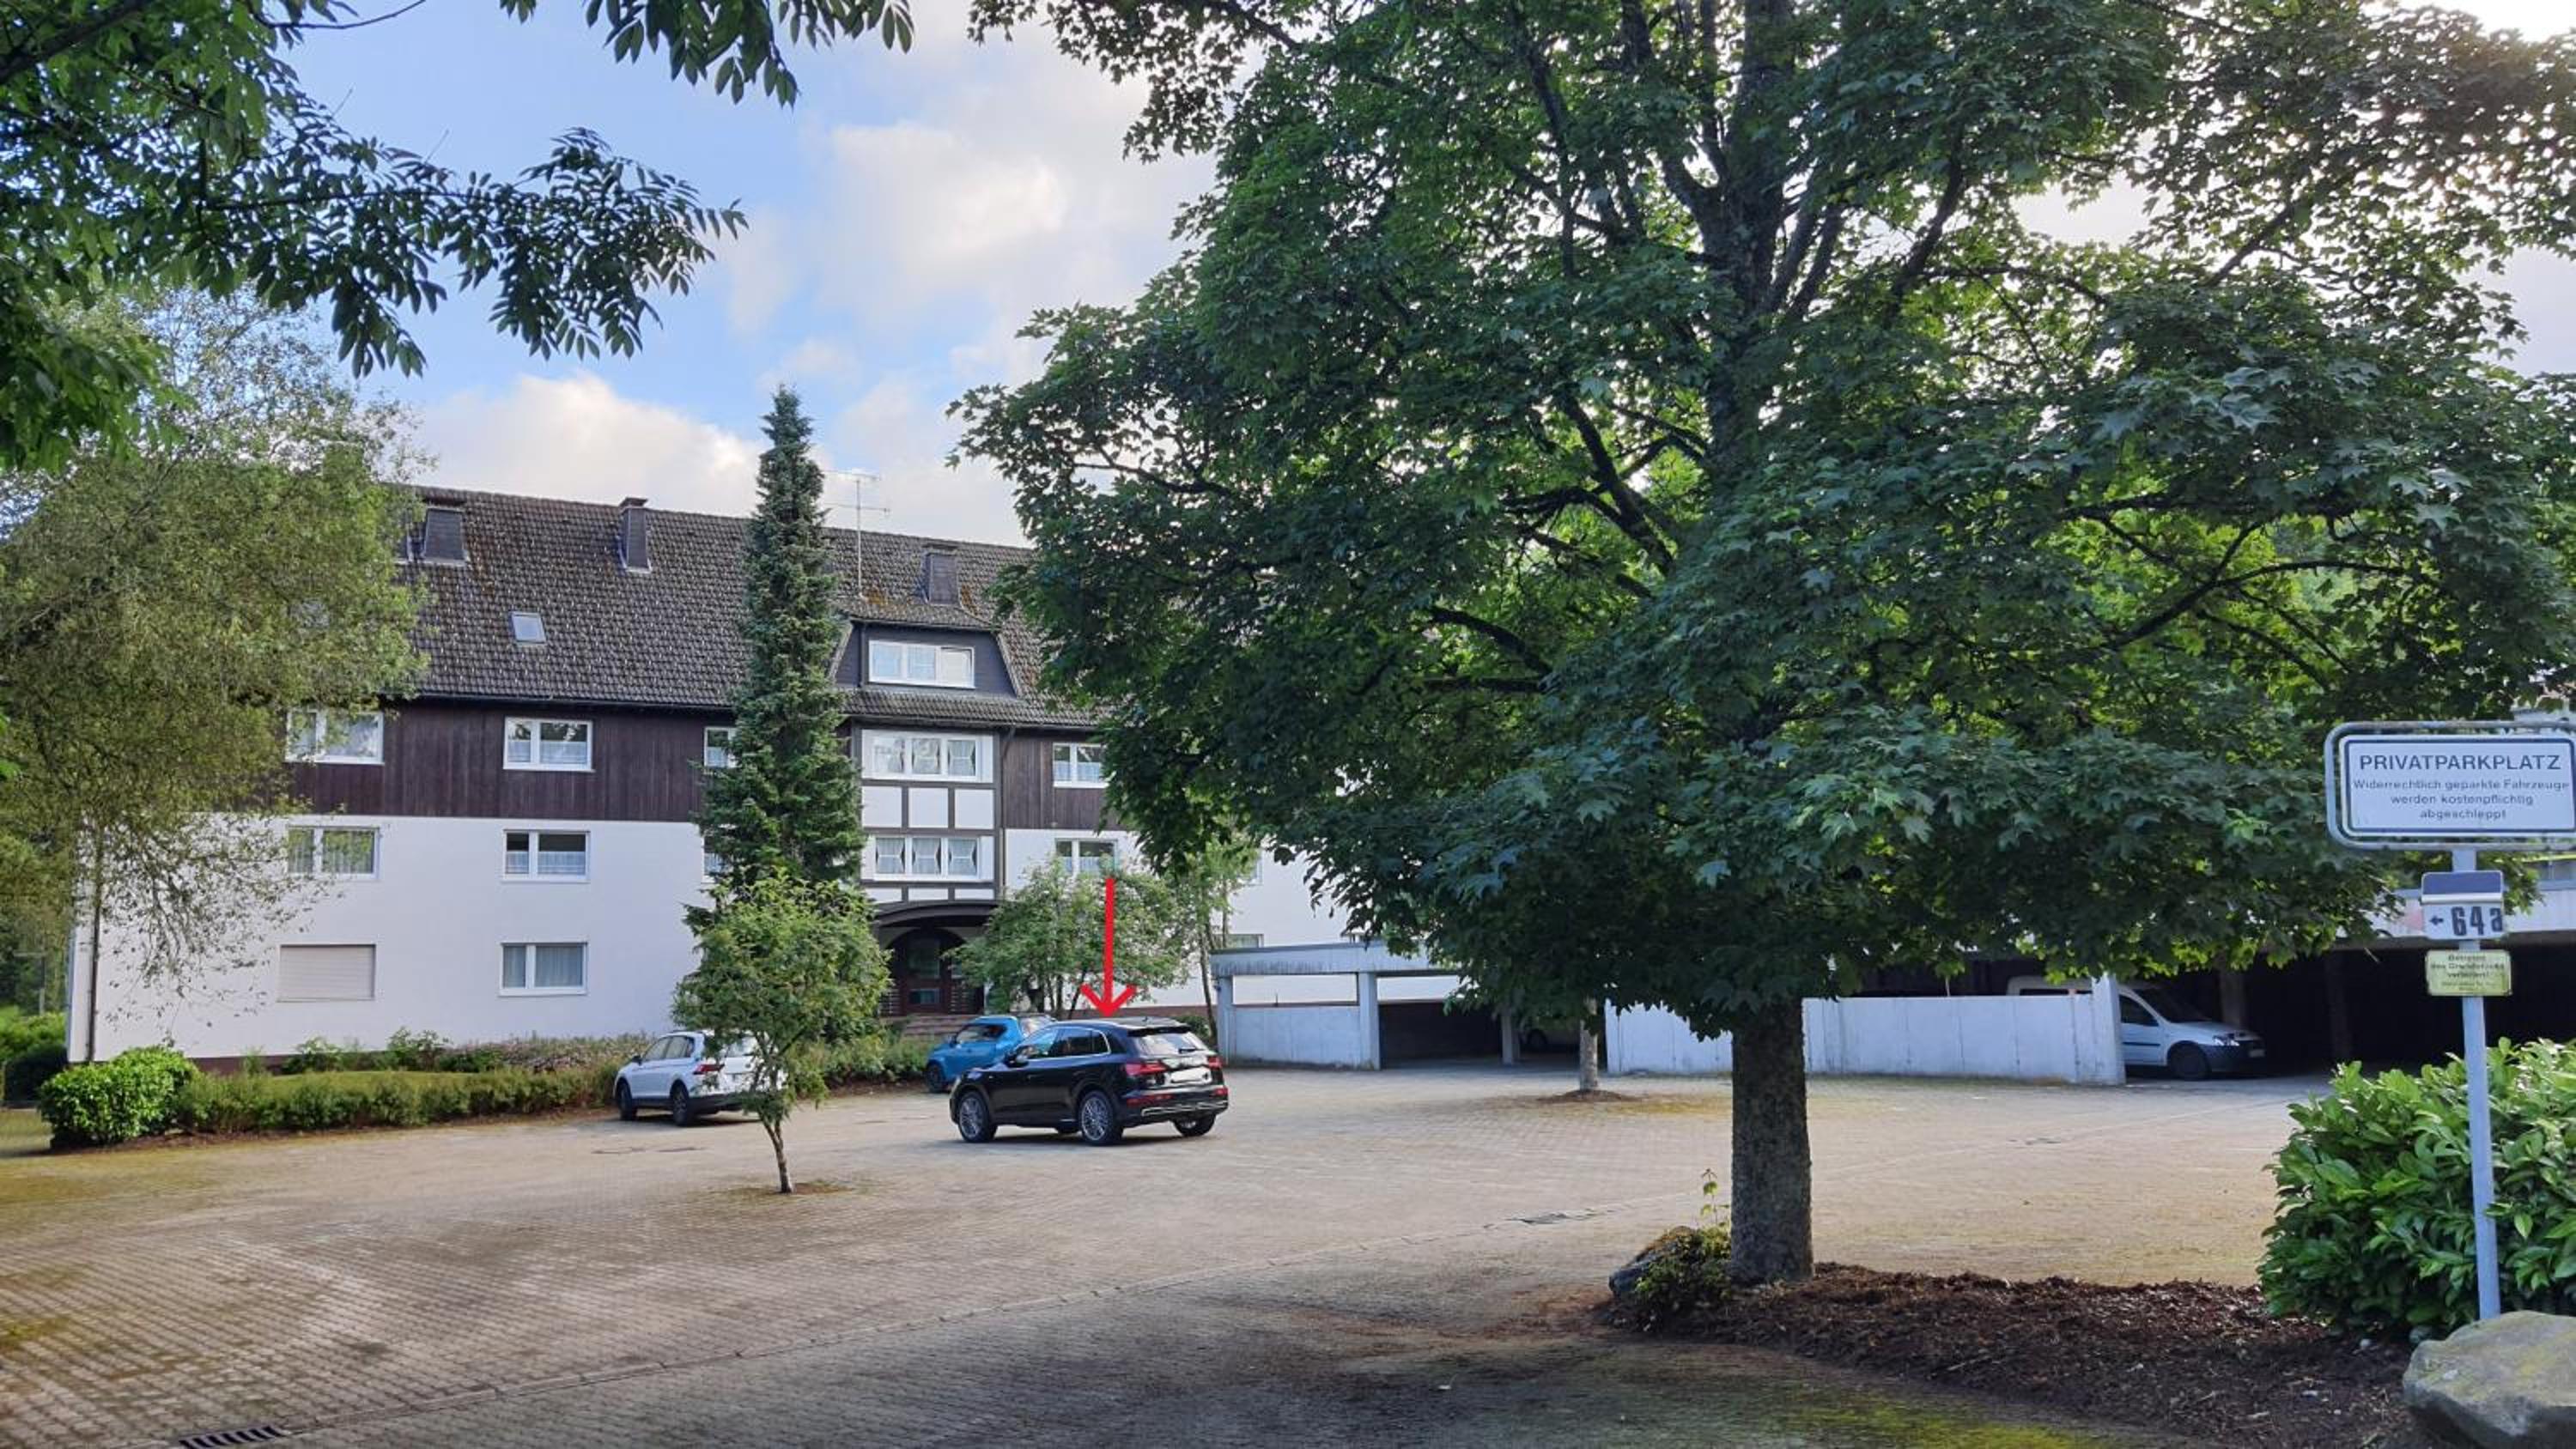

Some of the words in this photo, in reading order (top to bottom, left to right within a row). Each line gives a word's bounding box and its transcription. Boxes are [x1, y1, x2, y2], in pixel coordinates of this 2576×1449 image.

[2360, 755, 2561, 770] PRIVATPARKPLATZ
[2353, 779, 2442, 790] Widerrechtlich
[2445, 780, 2500, 791] geparkte
[2391, 795, 2436, 804] werden
[2441, 795, 2534, 806] kostenpflichtig
[2420, 809, 2506, 820] abgeschleppt
[2451, 906, 2503, 936] 64a
